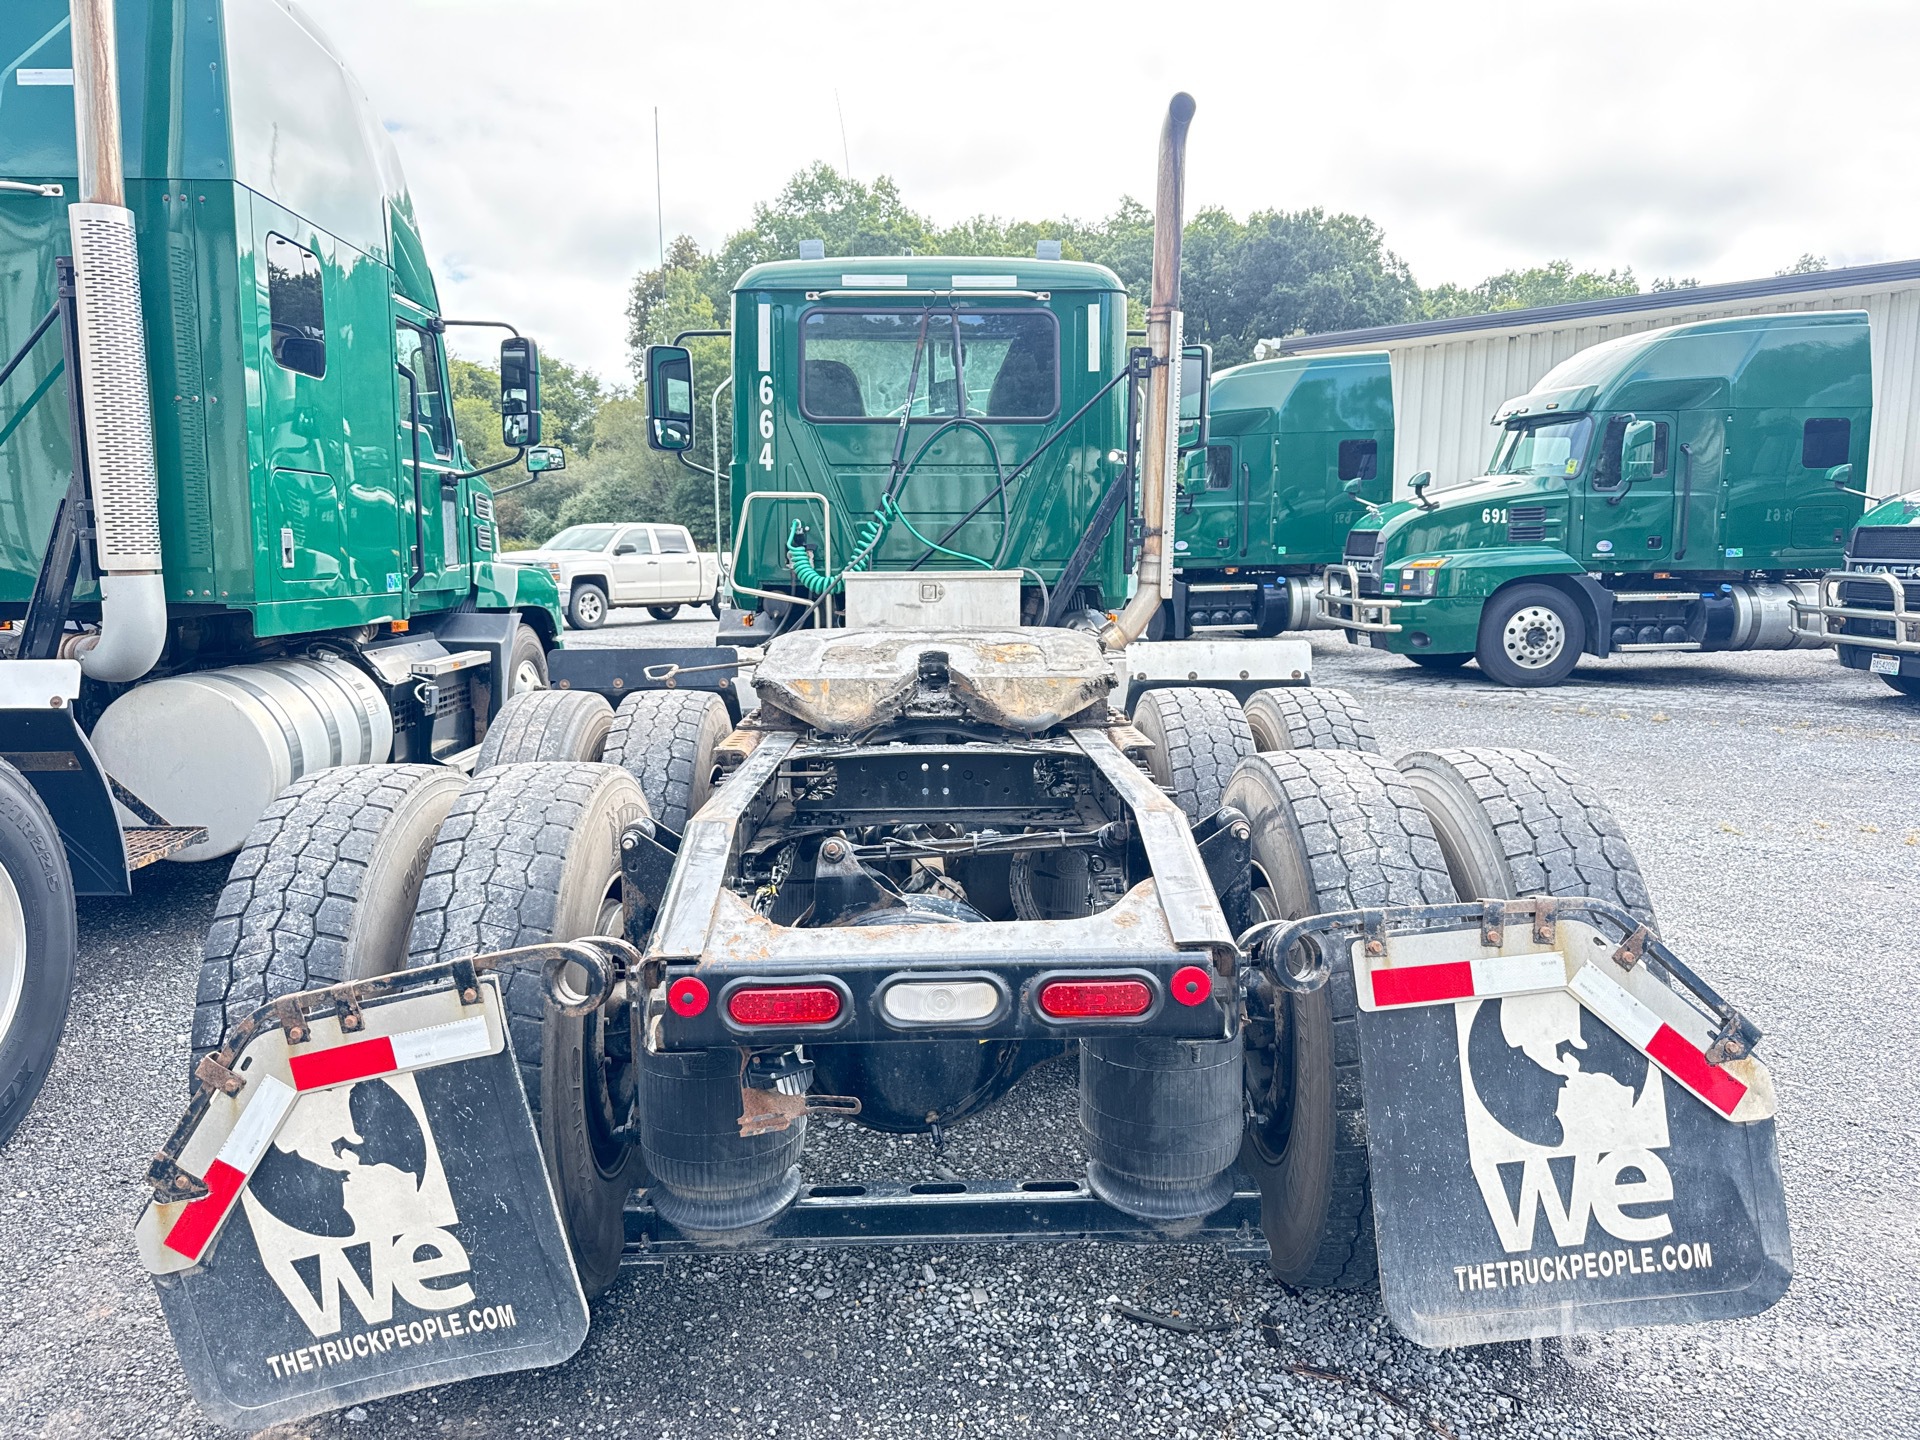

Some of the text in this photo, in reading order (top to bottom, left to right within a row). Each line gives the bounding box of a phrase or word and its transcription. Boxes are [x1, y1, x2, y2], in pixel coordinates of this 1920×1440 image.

[759, 375, 774, 471] 664
[1482, 508, 1508, 524] 691
[1454, 1243, 1713, 1292] THETRUCKPEOPLE.COM
[266, 1303, 517, 1379] THETRUCKPEOPLE.COM
